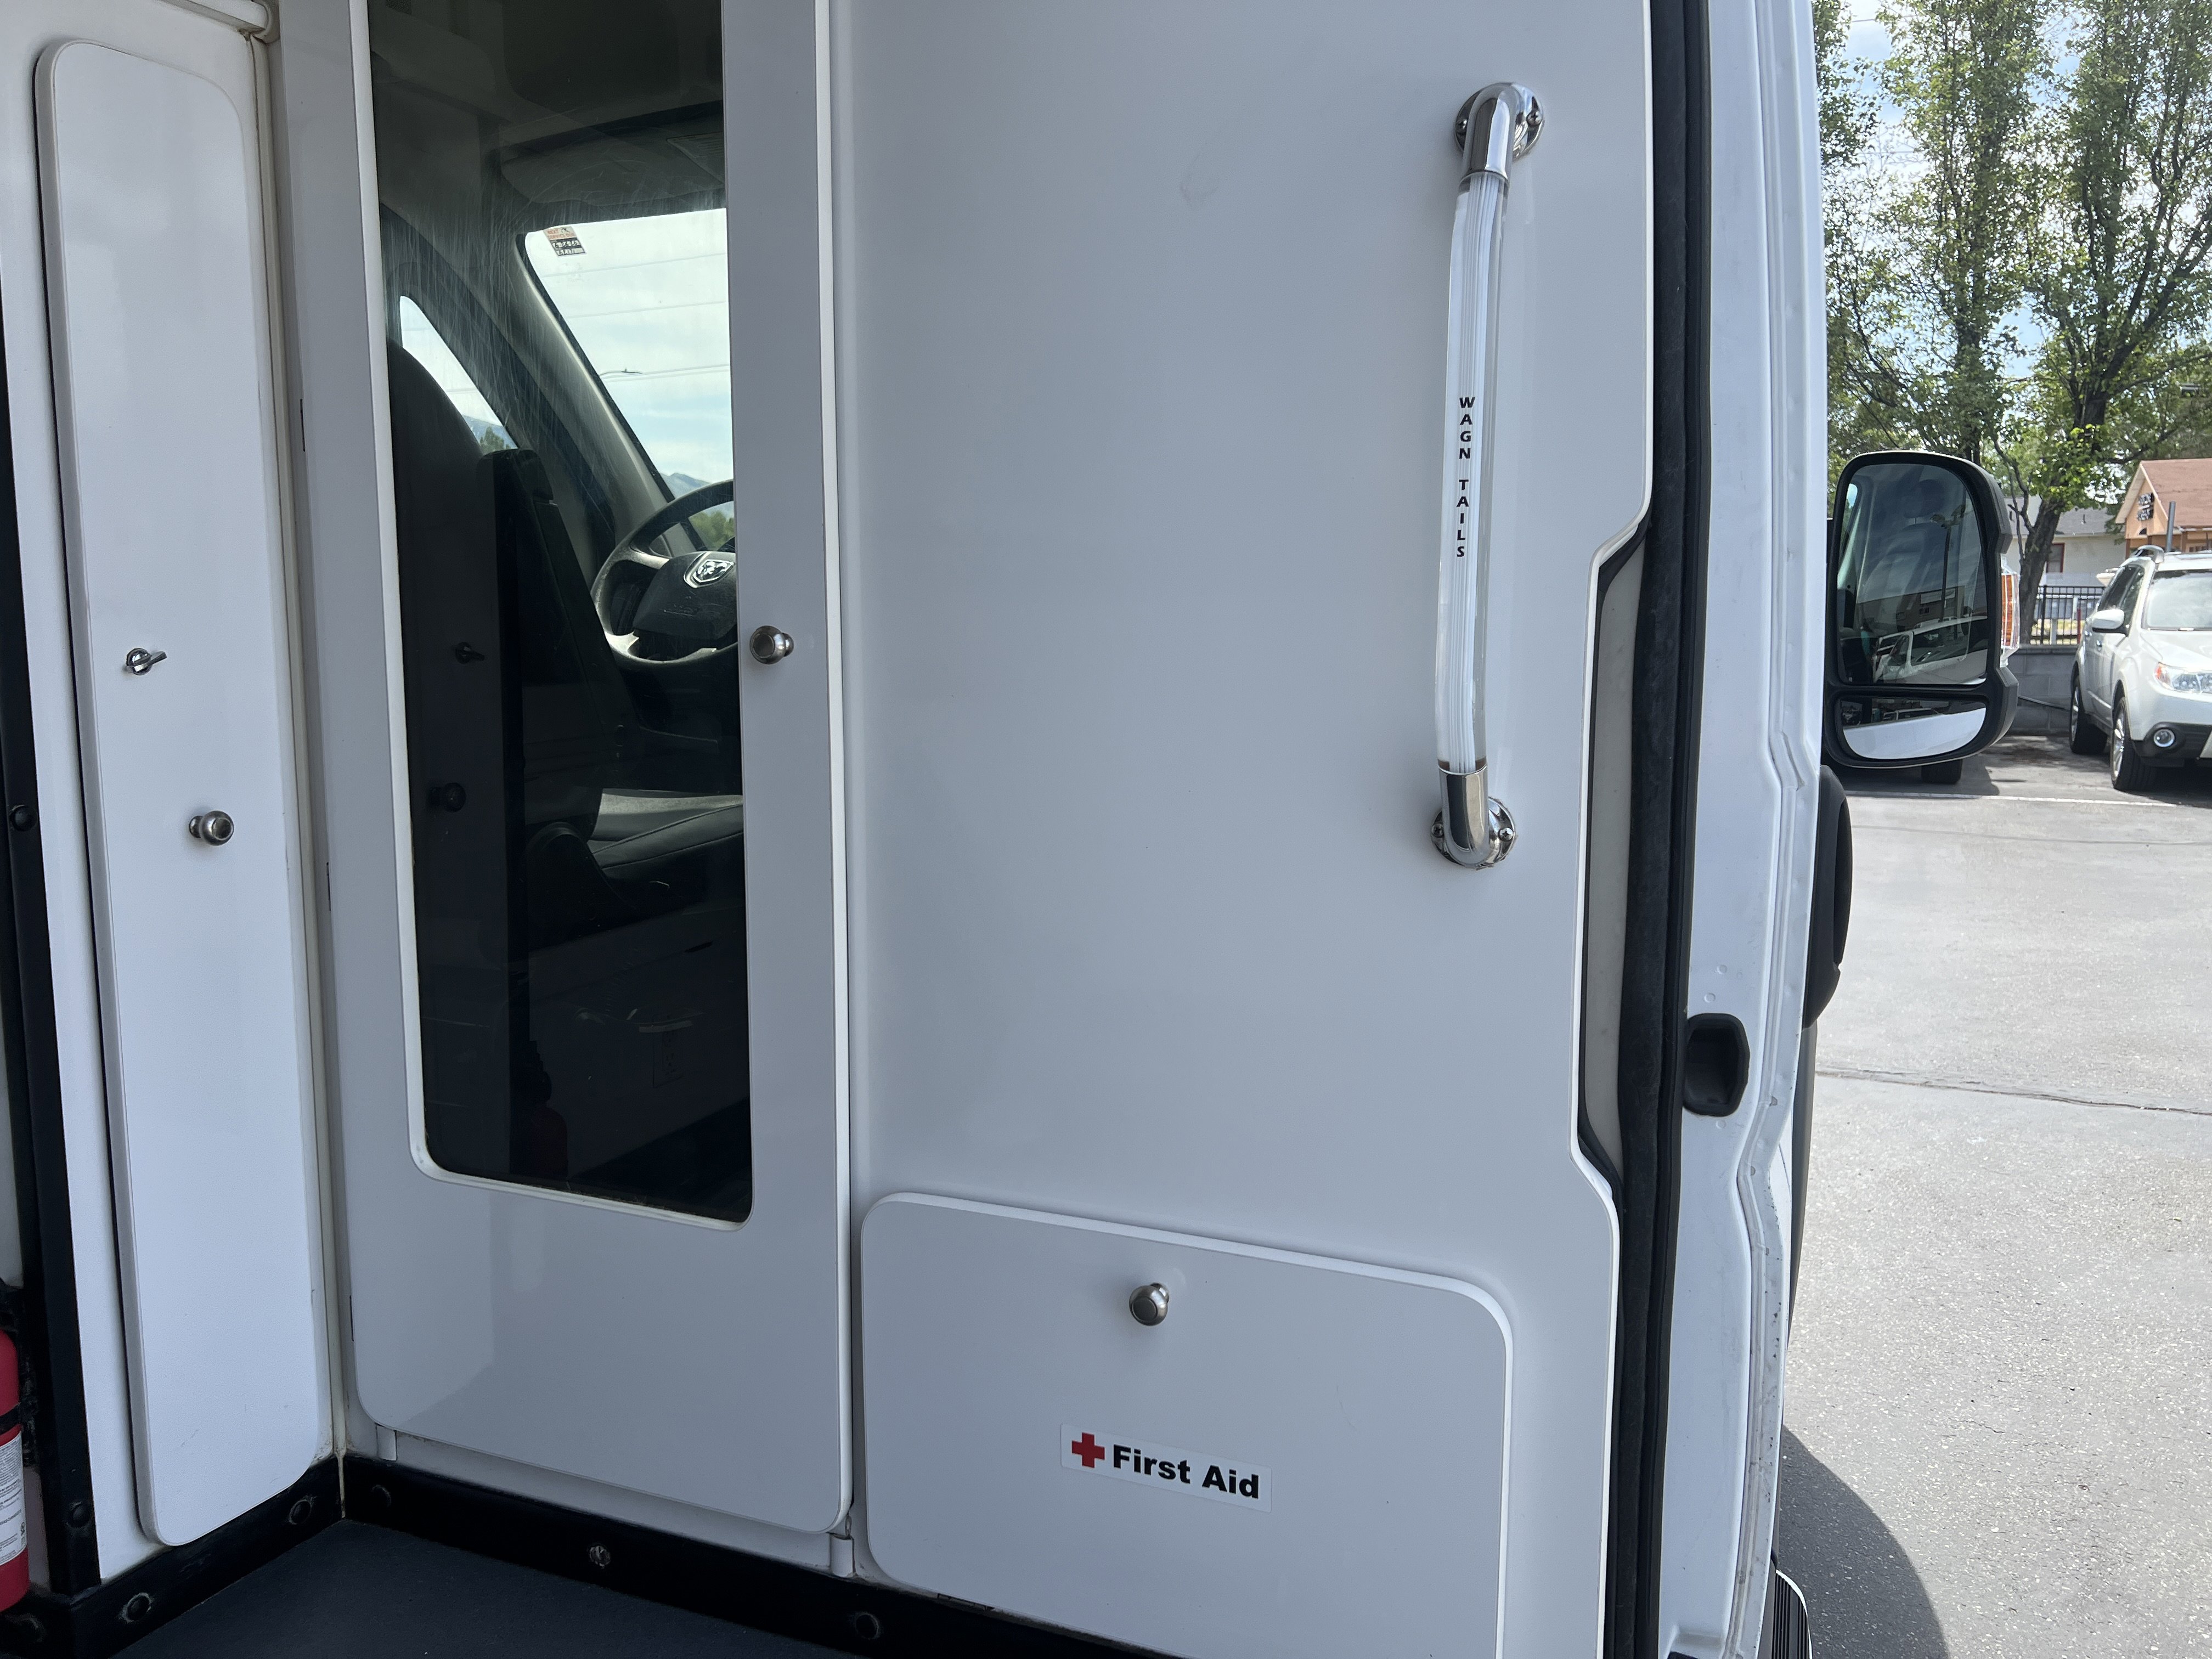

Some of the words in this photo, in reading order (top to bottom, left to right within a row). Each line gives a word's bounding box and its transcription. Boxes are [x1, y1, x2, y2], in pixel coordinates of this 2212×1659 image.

[1459, 397, 1475, 459] WAGN
[1456, 479, 1469, 557] TAILS
[1113, 1444, 1190, 1484] First
[1201, 1465, 1259, 1499] Aid
